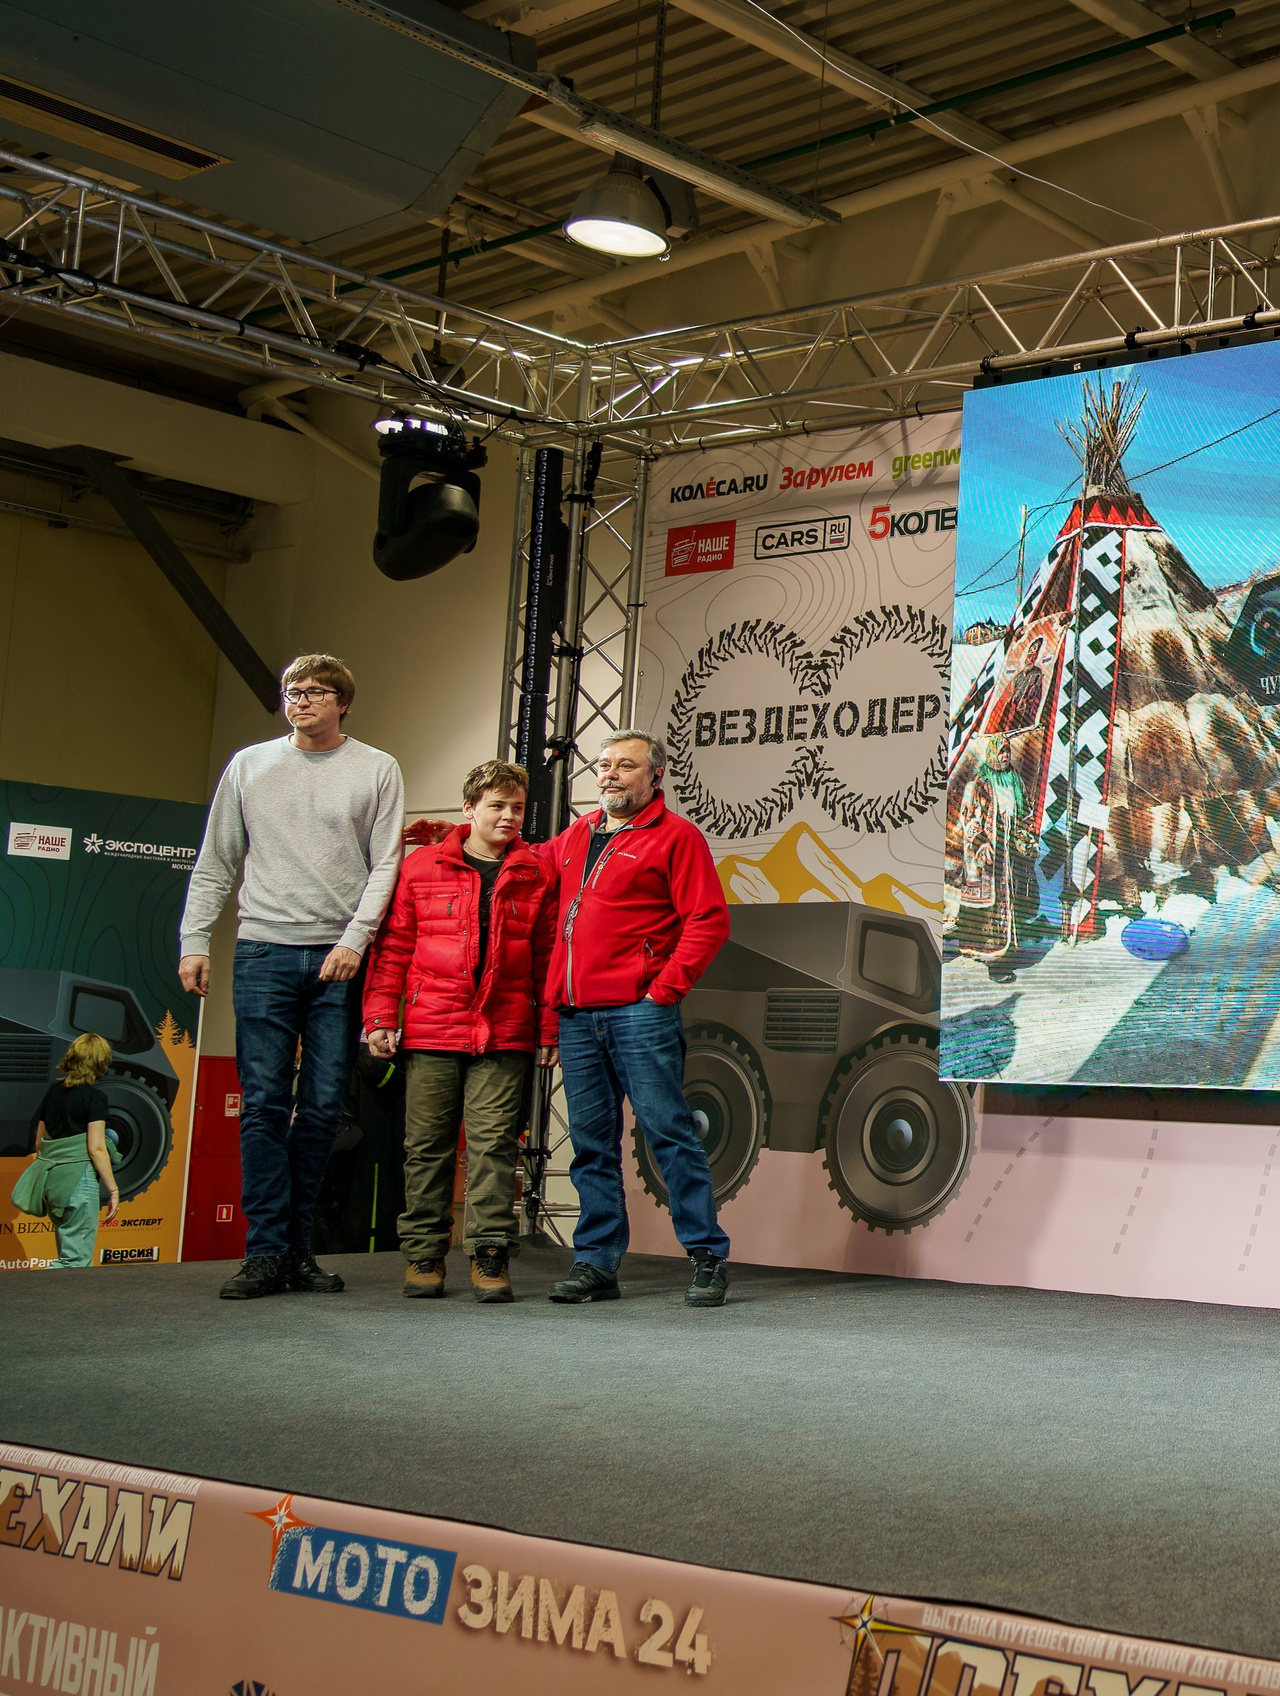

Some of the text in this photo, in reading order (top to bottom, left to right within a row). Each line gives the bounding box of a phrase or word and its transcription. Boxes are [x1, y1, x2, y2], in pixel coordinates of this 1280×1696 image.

[761, 521, 846, 551] CARS RU
[868, 504, 958, 541] 5КОЛЕ
[697, 553, 723, 563] РАДИО
[698, 535, 730, 554] НАШЕ
[694, 694, 941, 748] ВЕЗДЕХОДЕР
[38, 835, 67, 848] НАШЕ
[105, 840, 197, 858] ЭКСПОЦЕНТР
[99, 1218, 163, 1228] ЗОВ ЭКСПЕРТ
[0, 1257, 58, 1270] AutoPar
[0, 1466, 195, 1582] ЕХАЛИ
[293, 1535, 713, 1675] МОТО ЗИМА 24
[0, 1606, 160, 1696] КТИВНЫЙ
[922, 1606, 996, 1640] ВЫСТАВКА
[1000, 1620, 1108, 1661] ПУТЕШЕСТВИЙ
[1119, 1641, 1191, 1674] ТЕХНИКИ
[1189, 1653, 1229, 1680] ДЛЯ
